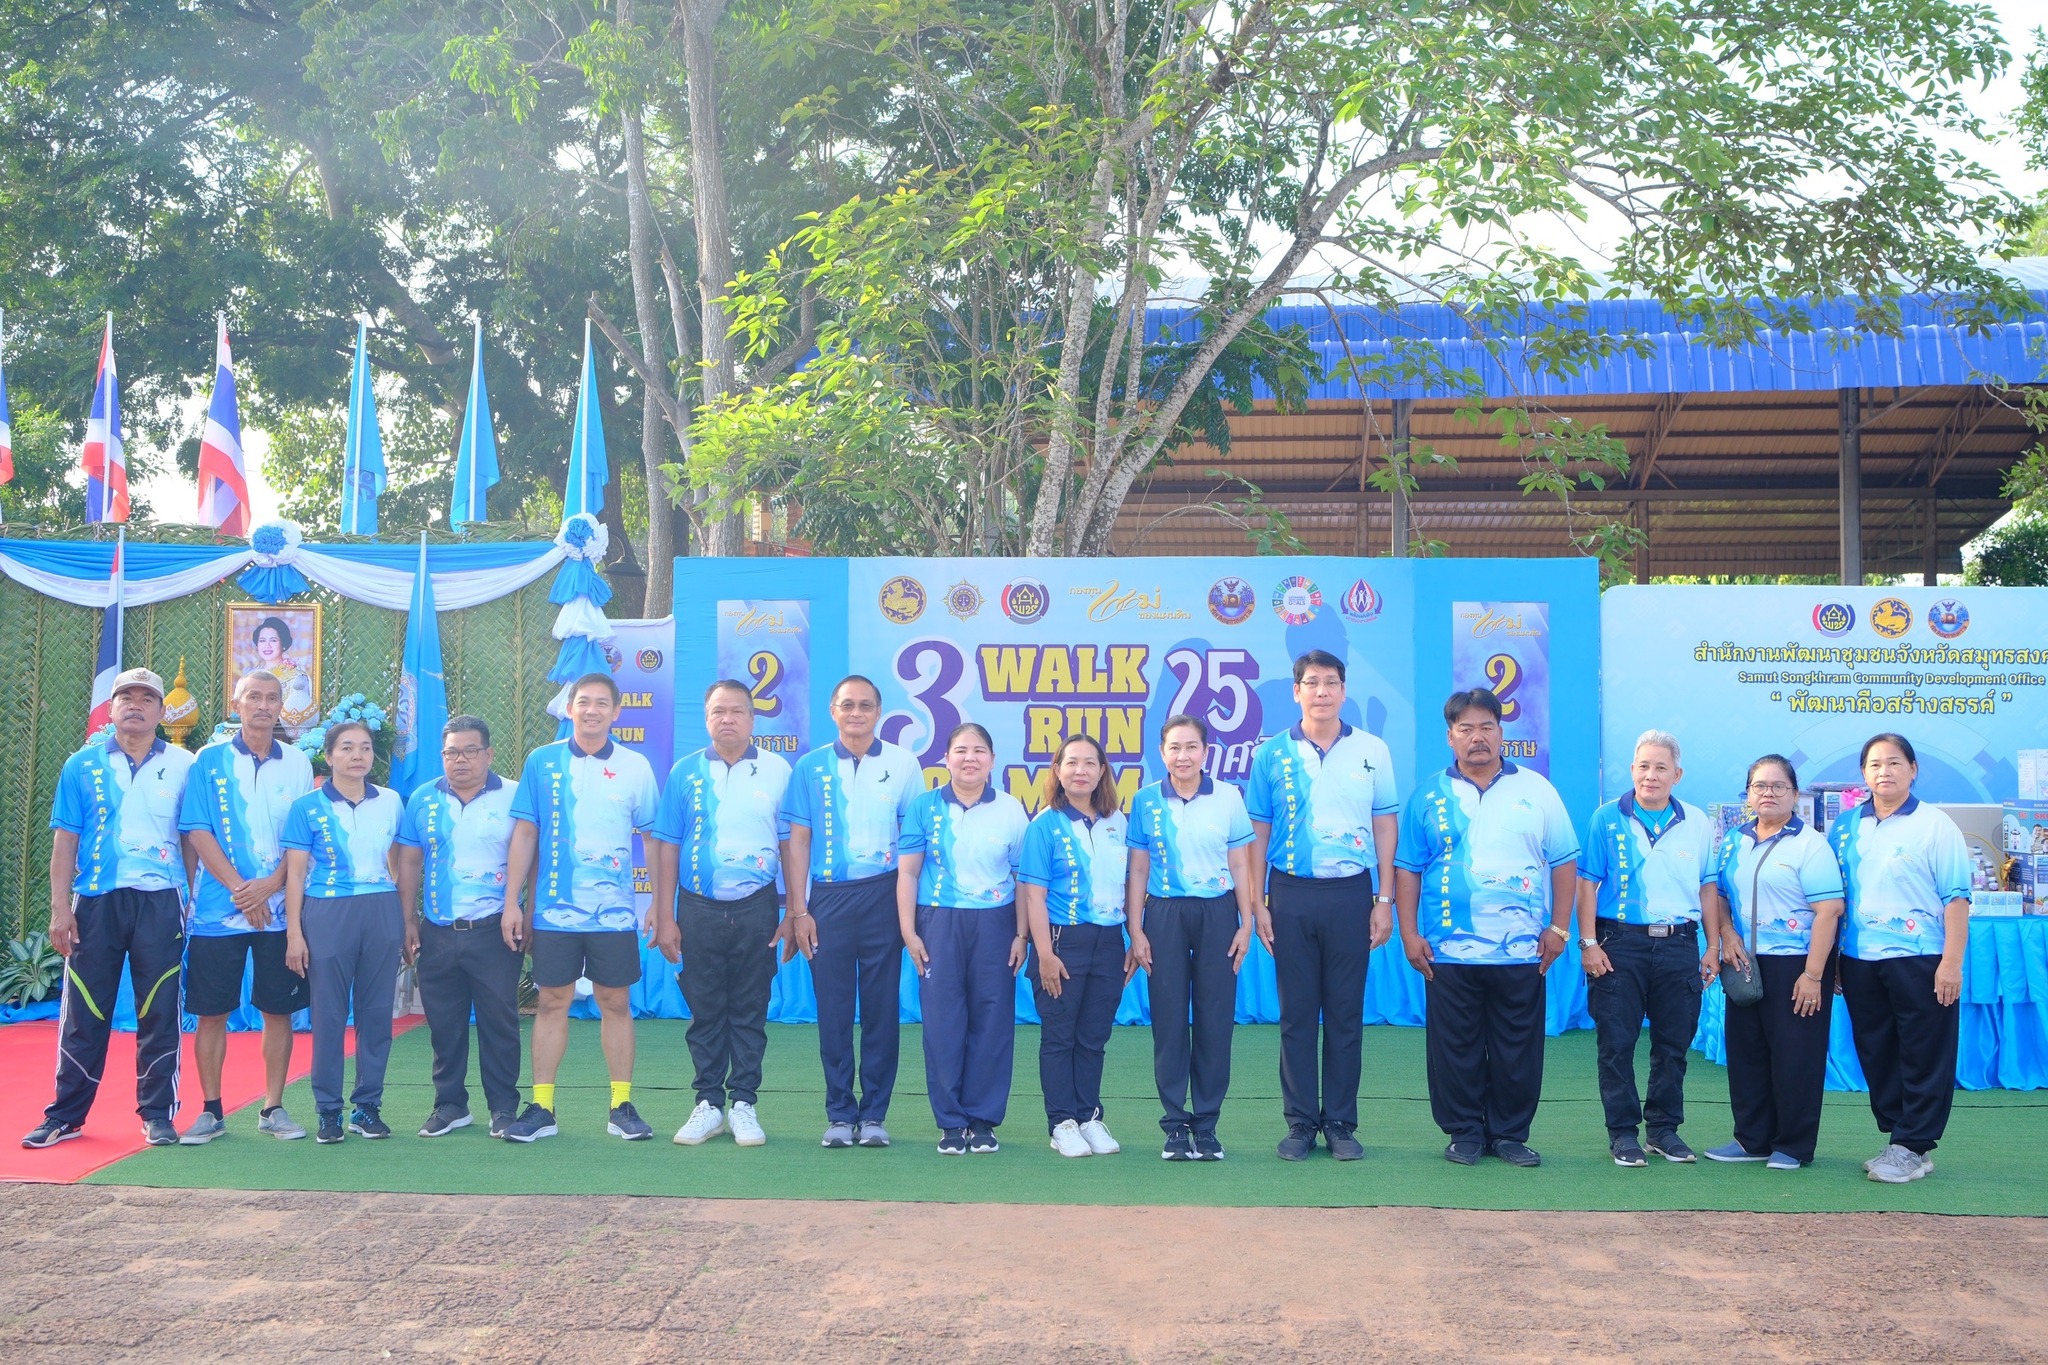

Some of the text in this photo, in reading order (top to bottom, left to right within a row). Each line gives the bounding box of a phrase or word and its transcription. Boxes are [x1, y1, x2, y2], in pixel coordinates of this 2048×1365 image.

[748, 650, 783, 715] 2
[979, 645, 1148, 697] WALK
[1485, 653, 1521, 720] 2
[1738, 671, 2046, 687] Samut Songkhram Community Development Office
[619, 692, 653, 708] ALK
[1788, 689, 1996, 713] พัฒนาคือสร้างสรรค์
[1027, 706, 1144, 757] RUN
[92, 768, 105, 802] WALK
[1281, 757, 1294, 789] WALK
[216, 778, 229, 812] WALK
[552, 772, 562, 806] WALK
[693, 779, 704, 811] WALK
[822, 775, 832, 807] WALK
[1008, 768, 1141, 814] MM
[317, 816, 332, 842] WALK
[428, 803, 439, 832] WALK
[552, 811, 560, 836] RUN
[932, 815, 943, 844] WALK
[1152, 808, 1162, 837] WALK
[1434, 798, 1449, 831] WALK
[825, 840, 833, 864] FOR
[1062, 837, 1077, 867] WALK
[549, 871, 559, 897] MOM
[1441, 866, 1449, 893] FOR
[1616, 834, 1629, 920] WALK RUN FO
[1441, 900, 1452, 927] MOM
